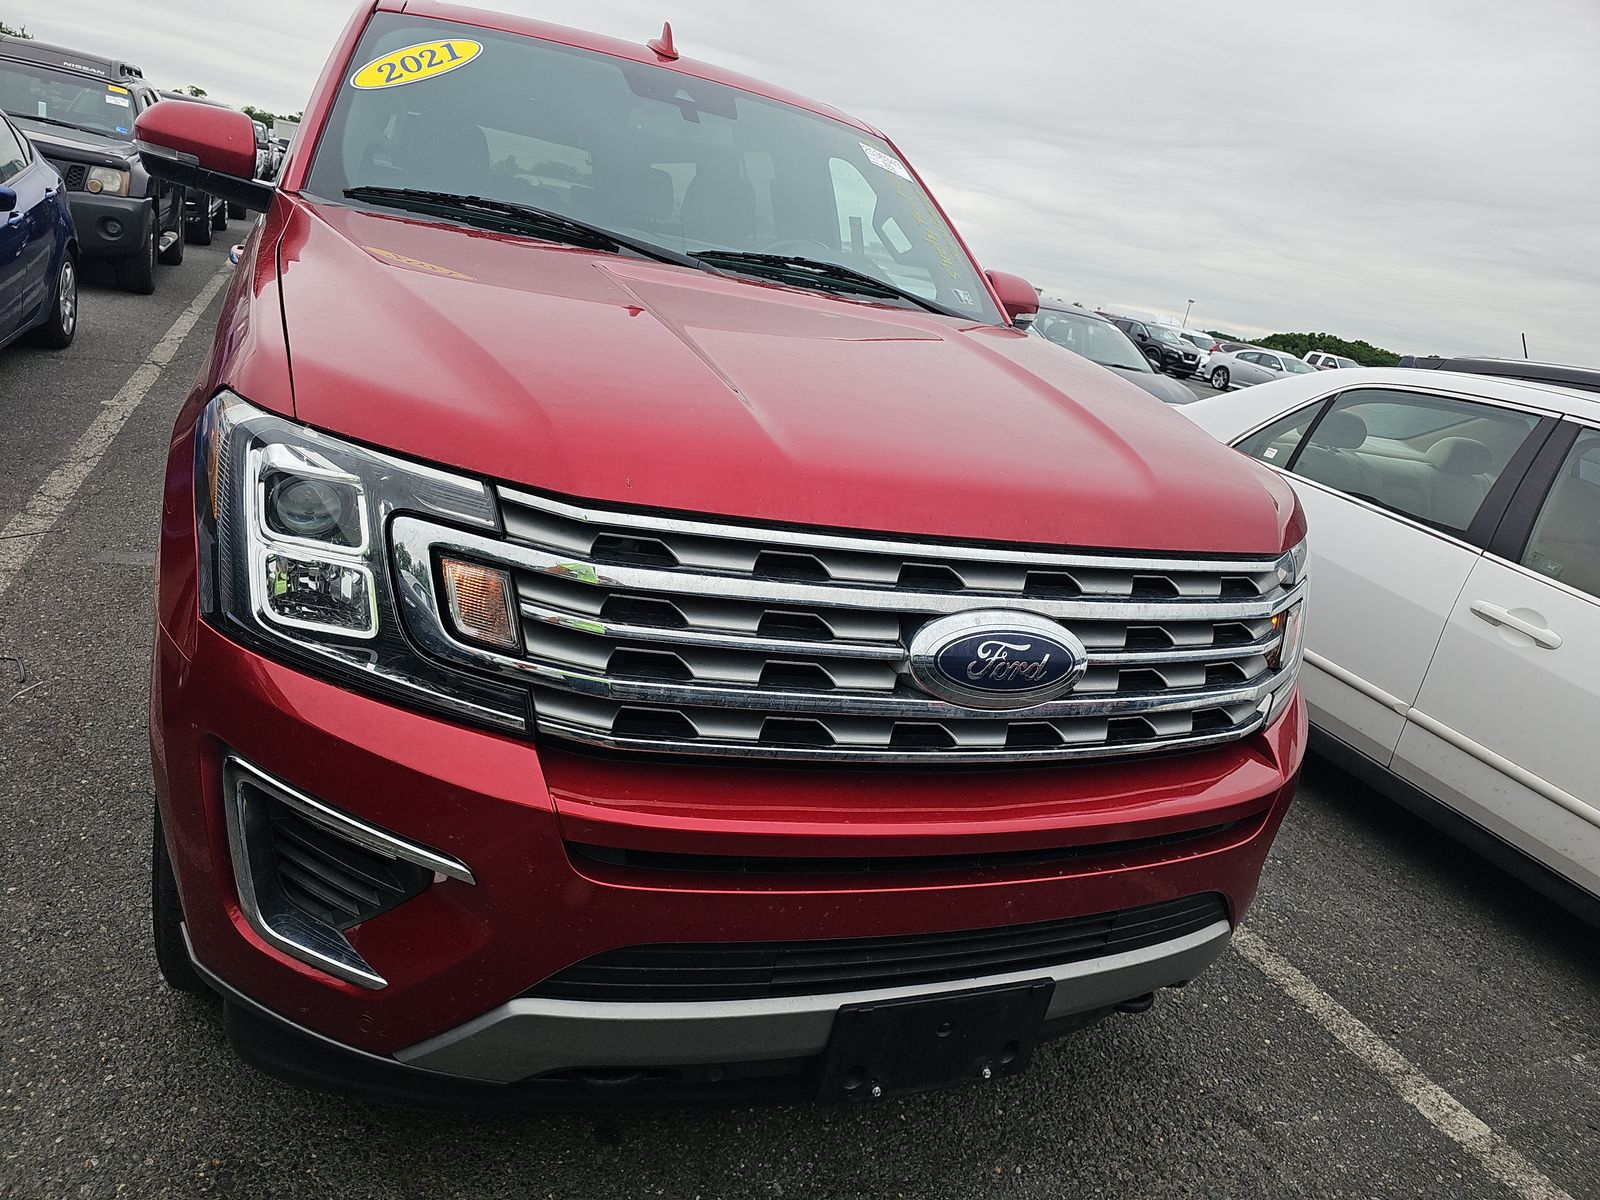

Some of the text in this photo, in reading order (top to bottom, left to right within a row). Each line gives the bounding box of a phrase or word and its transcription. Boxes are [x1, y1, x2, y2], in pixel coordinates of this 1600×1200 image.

[63, 61, 105, 76] NISSAN
[377, 42, 463, 83] 2021
[966, 640, 1051, 681] Ford
